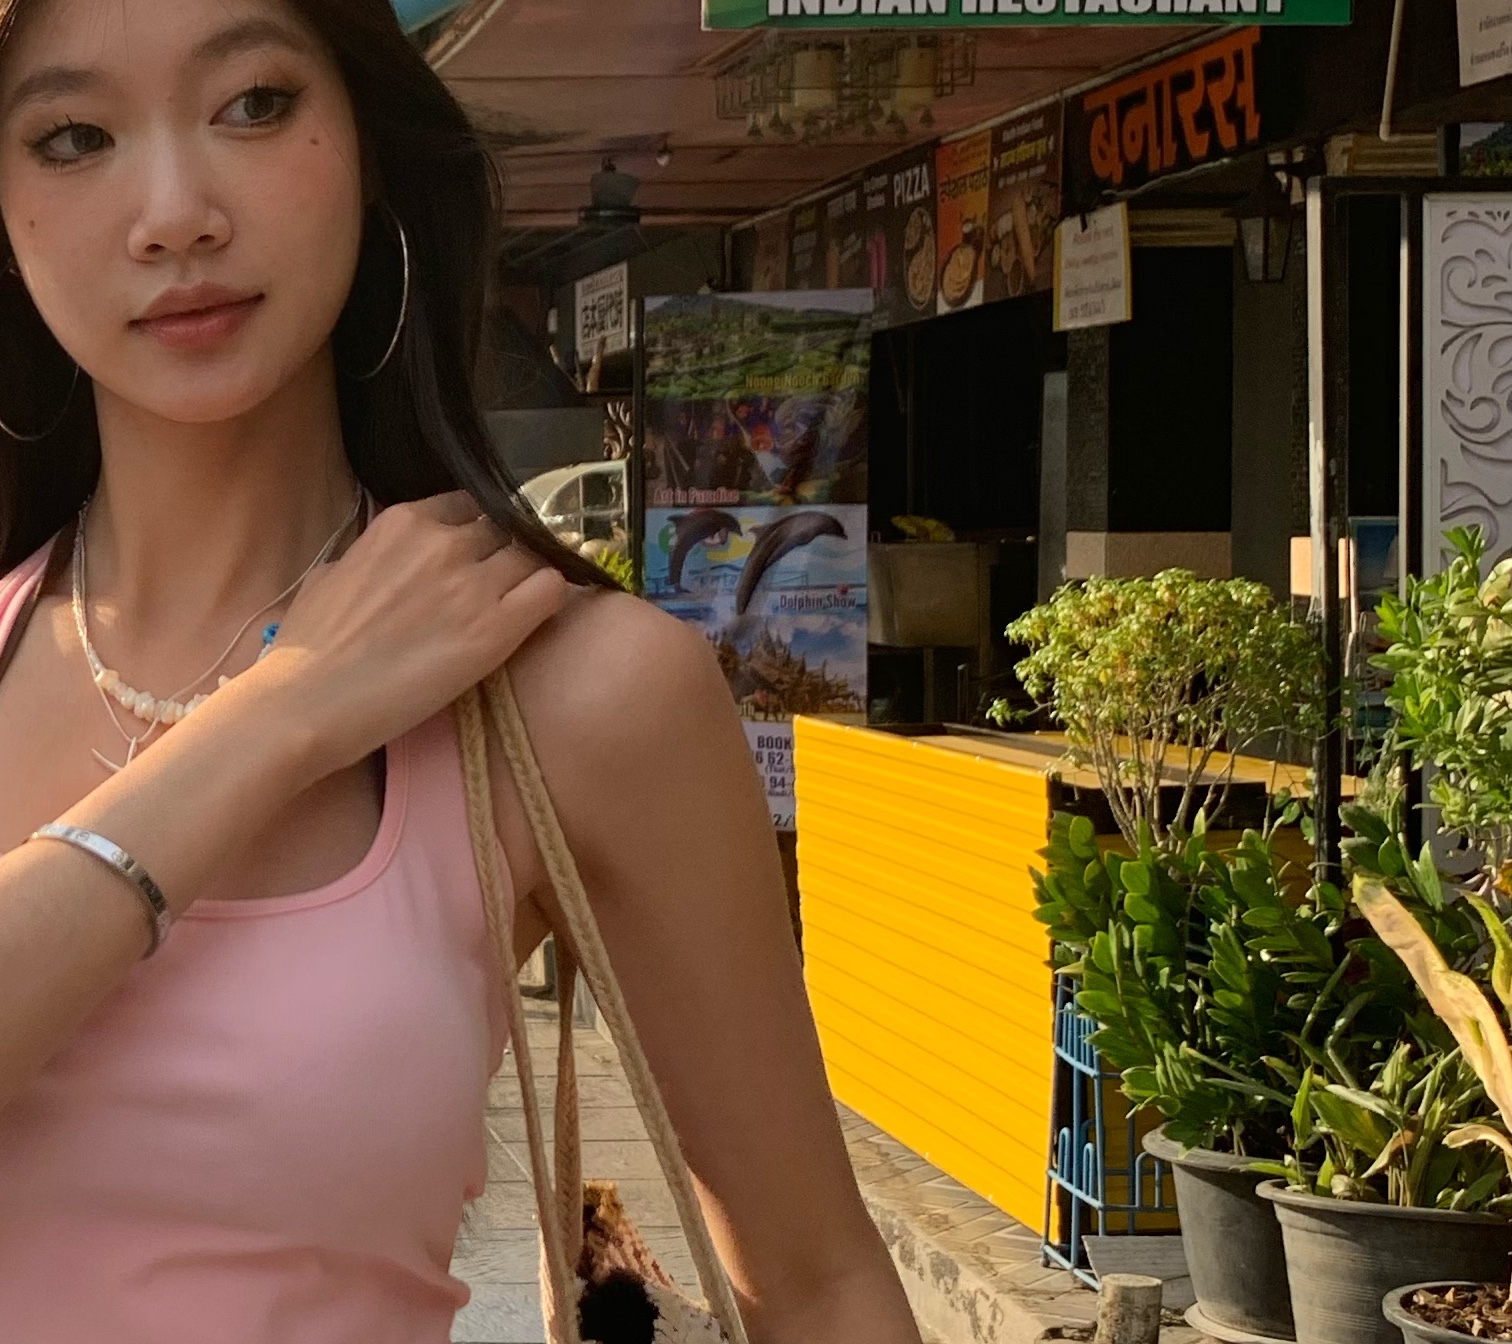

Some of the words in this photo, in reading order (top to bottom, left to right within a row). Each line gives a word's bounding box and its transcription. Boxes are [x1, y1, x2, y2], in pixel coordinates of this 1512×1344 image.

[1083, 25, 1261, 186] बनारस
[893, 163, 930, 207] PIZZA
[780, 593, 822, 610] Dolphin
[826, 593, 856, 608] Show
